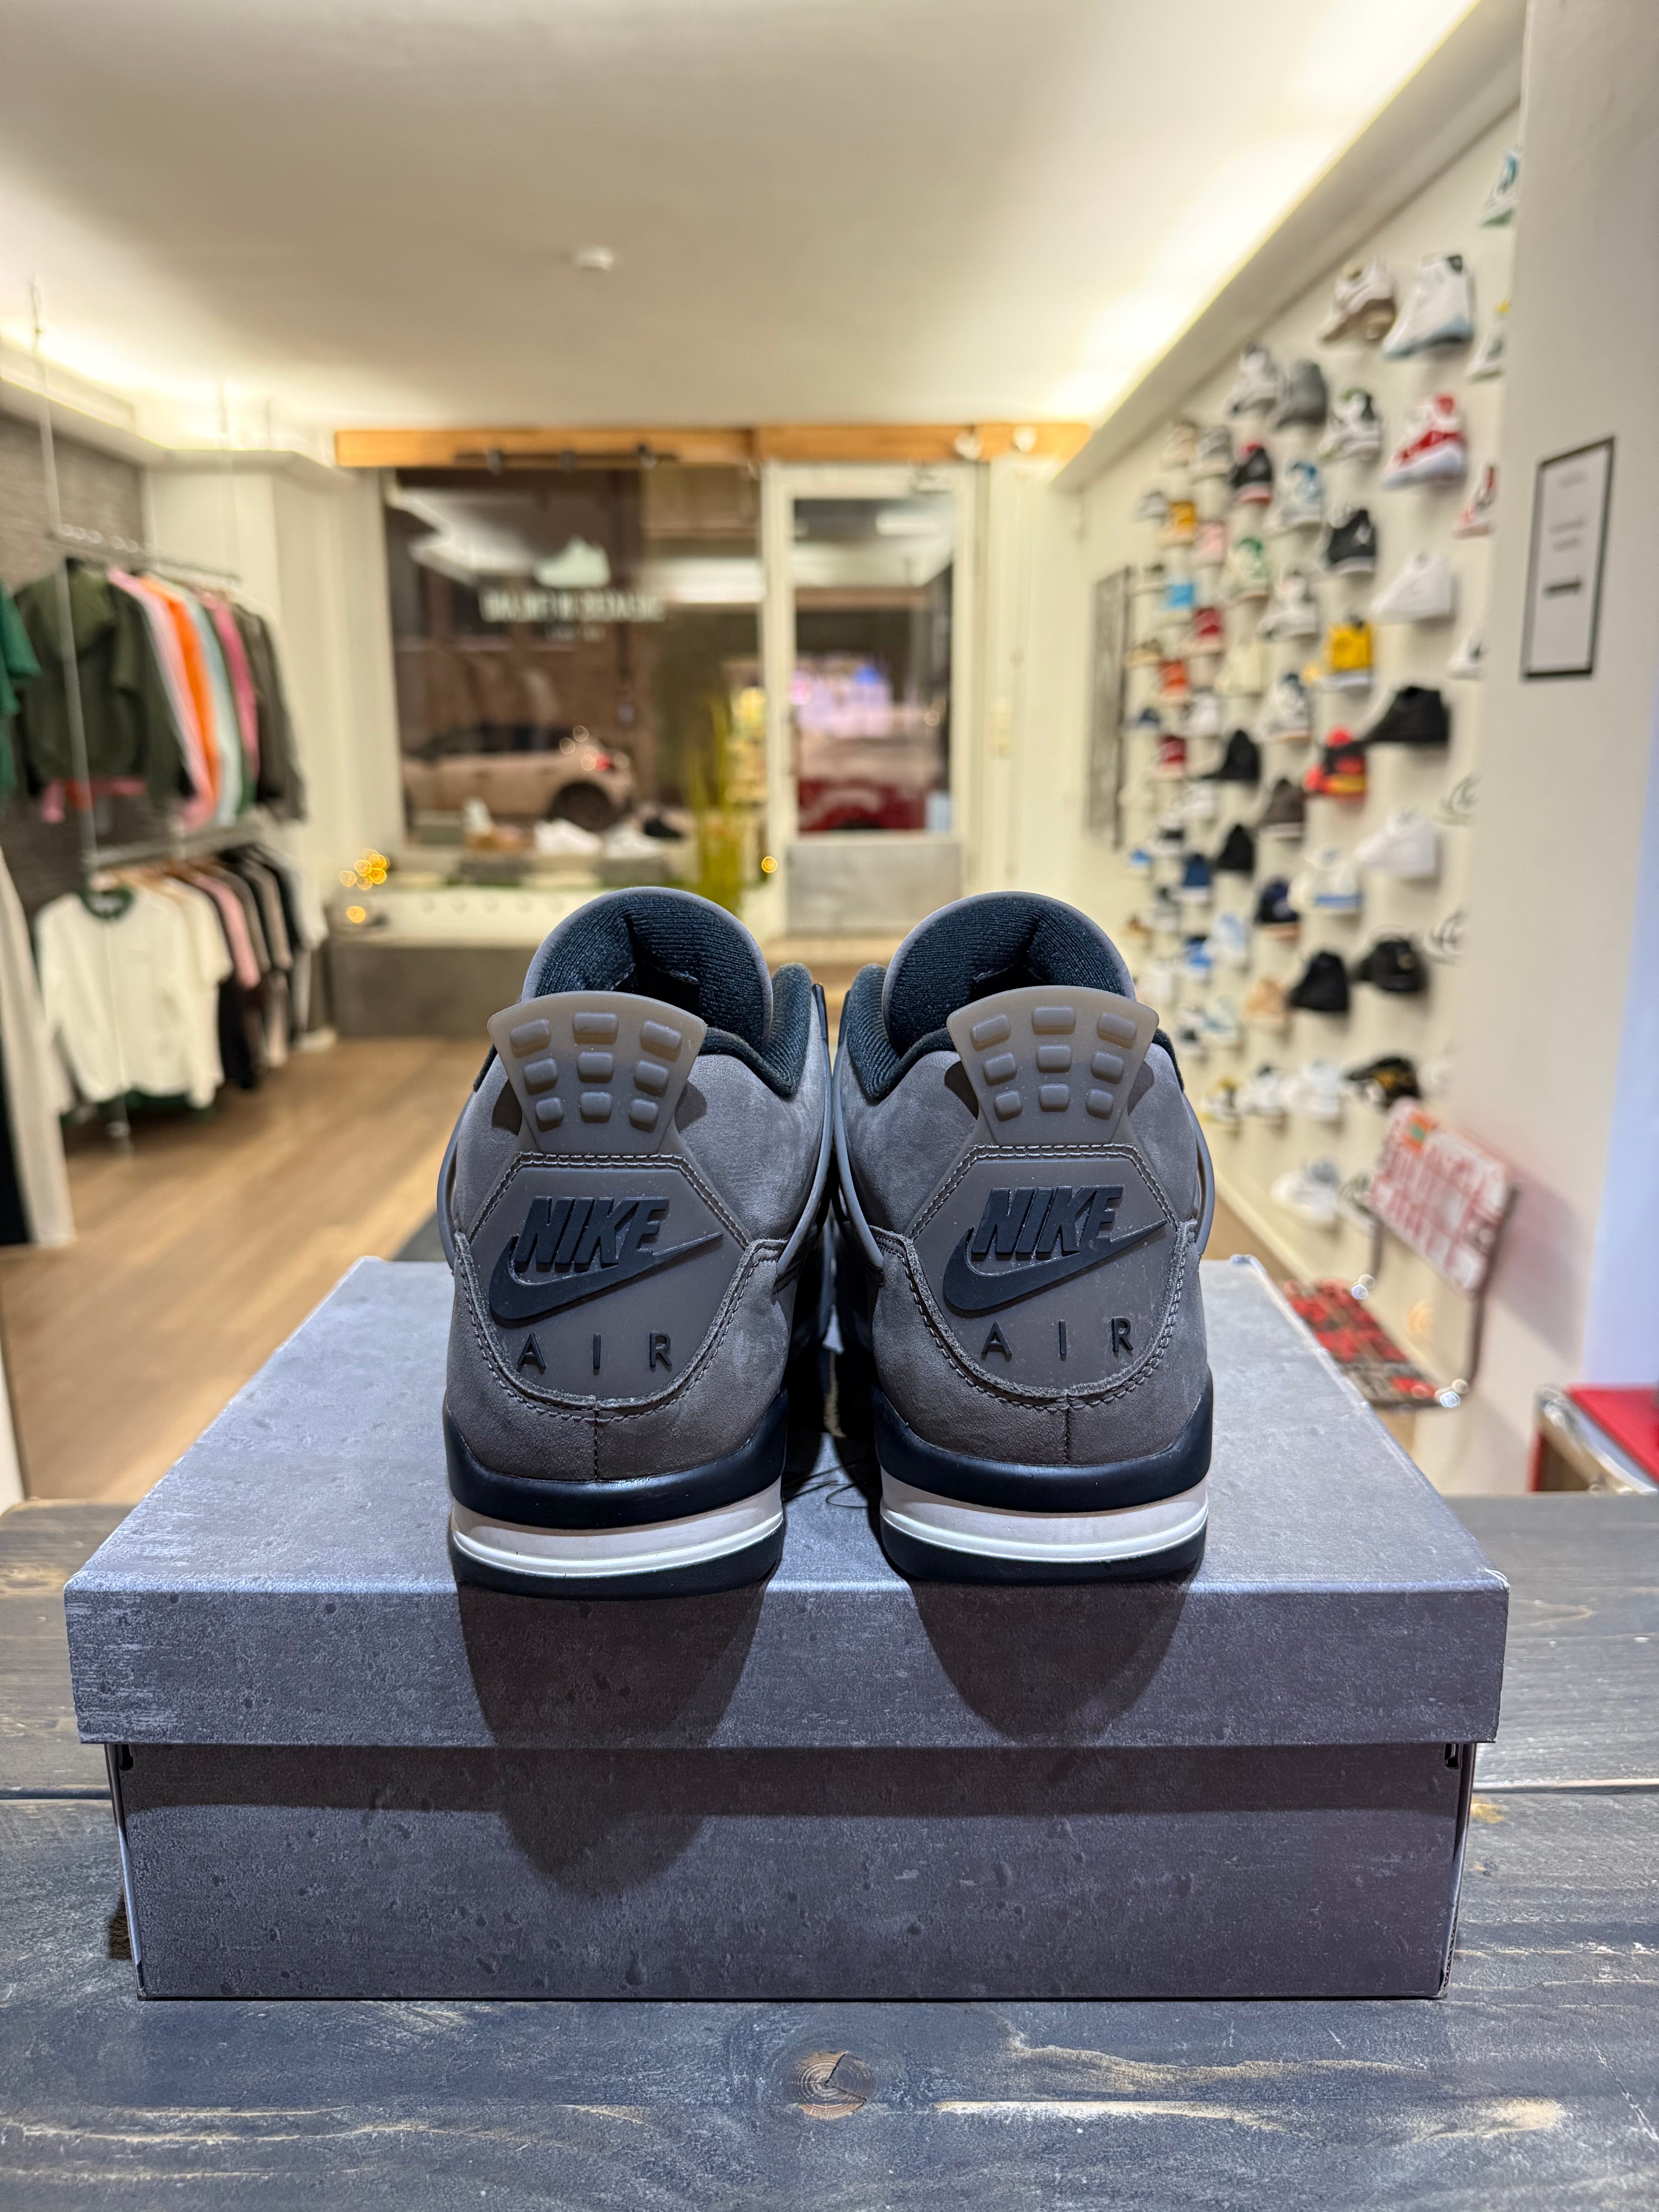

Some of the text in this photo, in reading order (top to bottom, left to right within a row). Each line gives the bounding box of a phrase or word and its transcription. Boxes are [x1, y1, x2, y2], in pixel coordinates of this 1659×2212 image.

[515, 1196, 670, 1268] NIKE
[971, 1185, 1123, 1258] NIKE
[518, 1331, 672, 1370] AIR
[981, 1316, 1133, 1357] AIR
